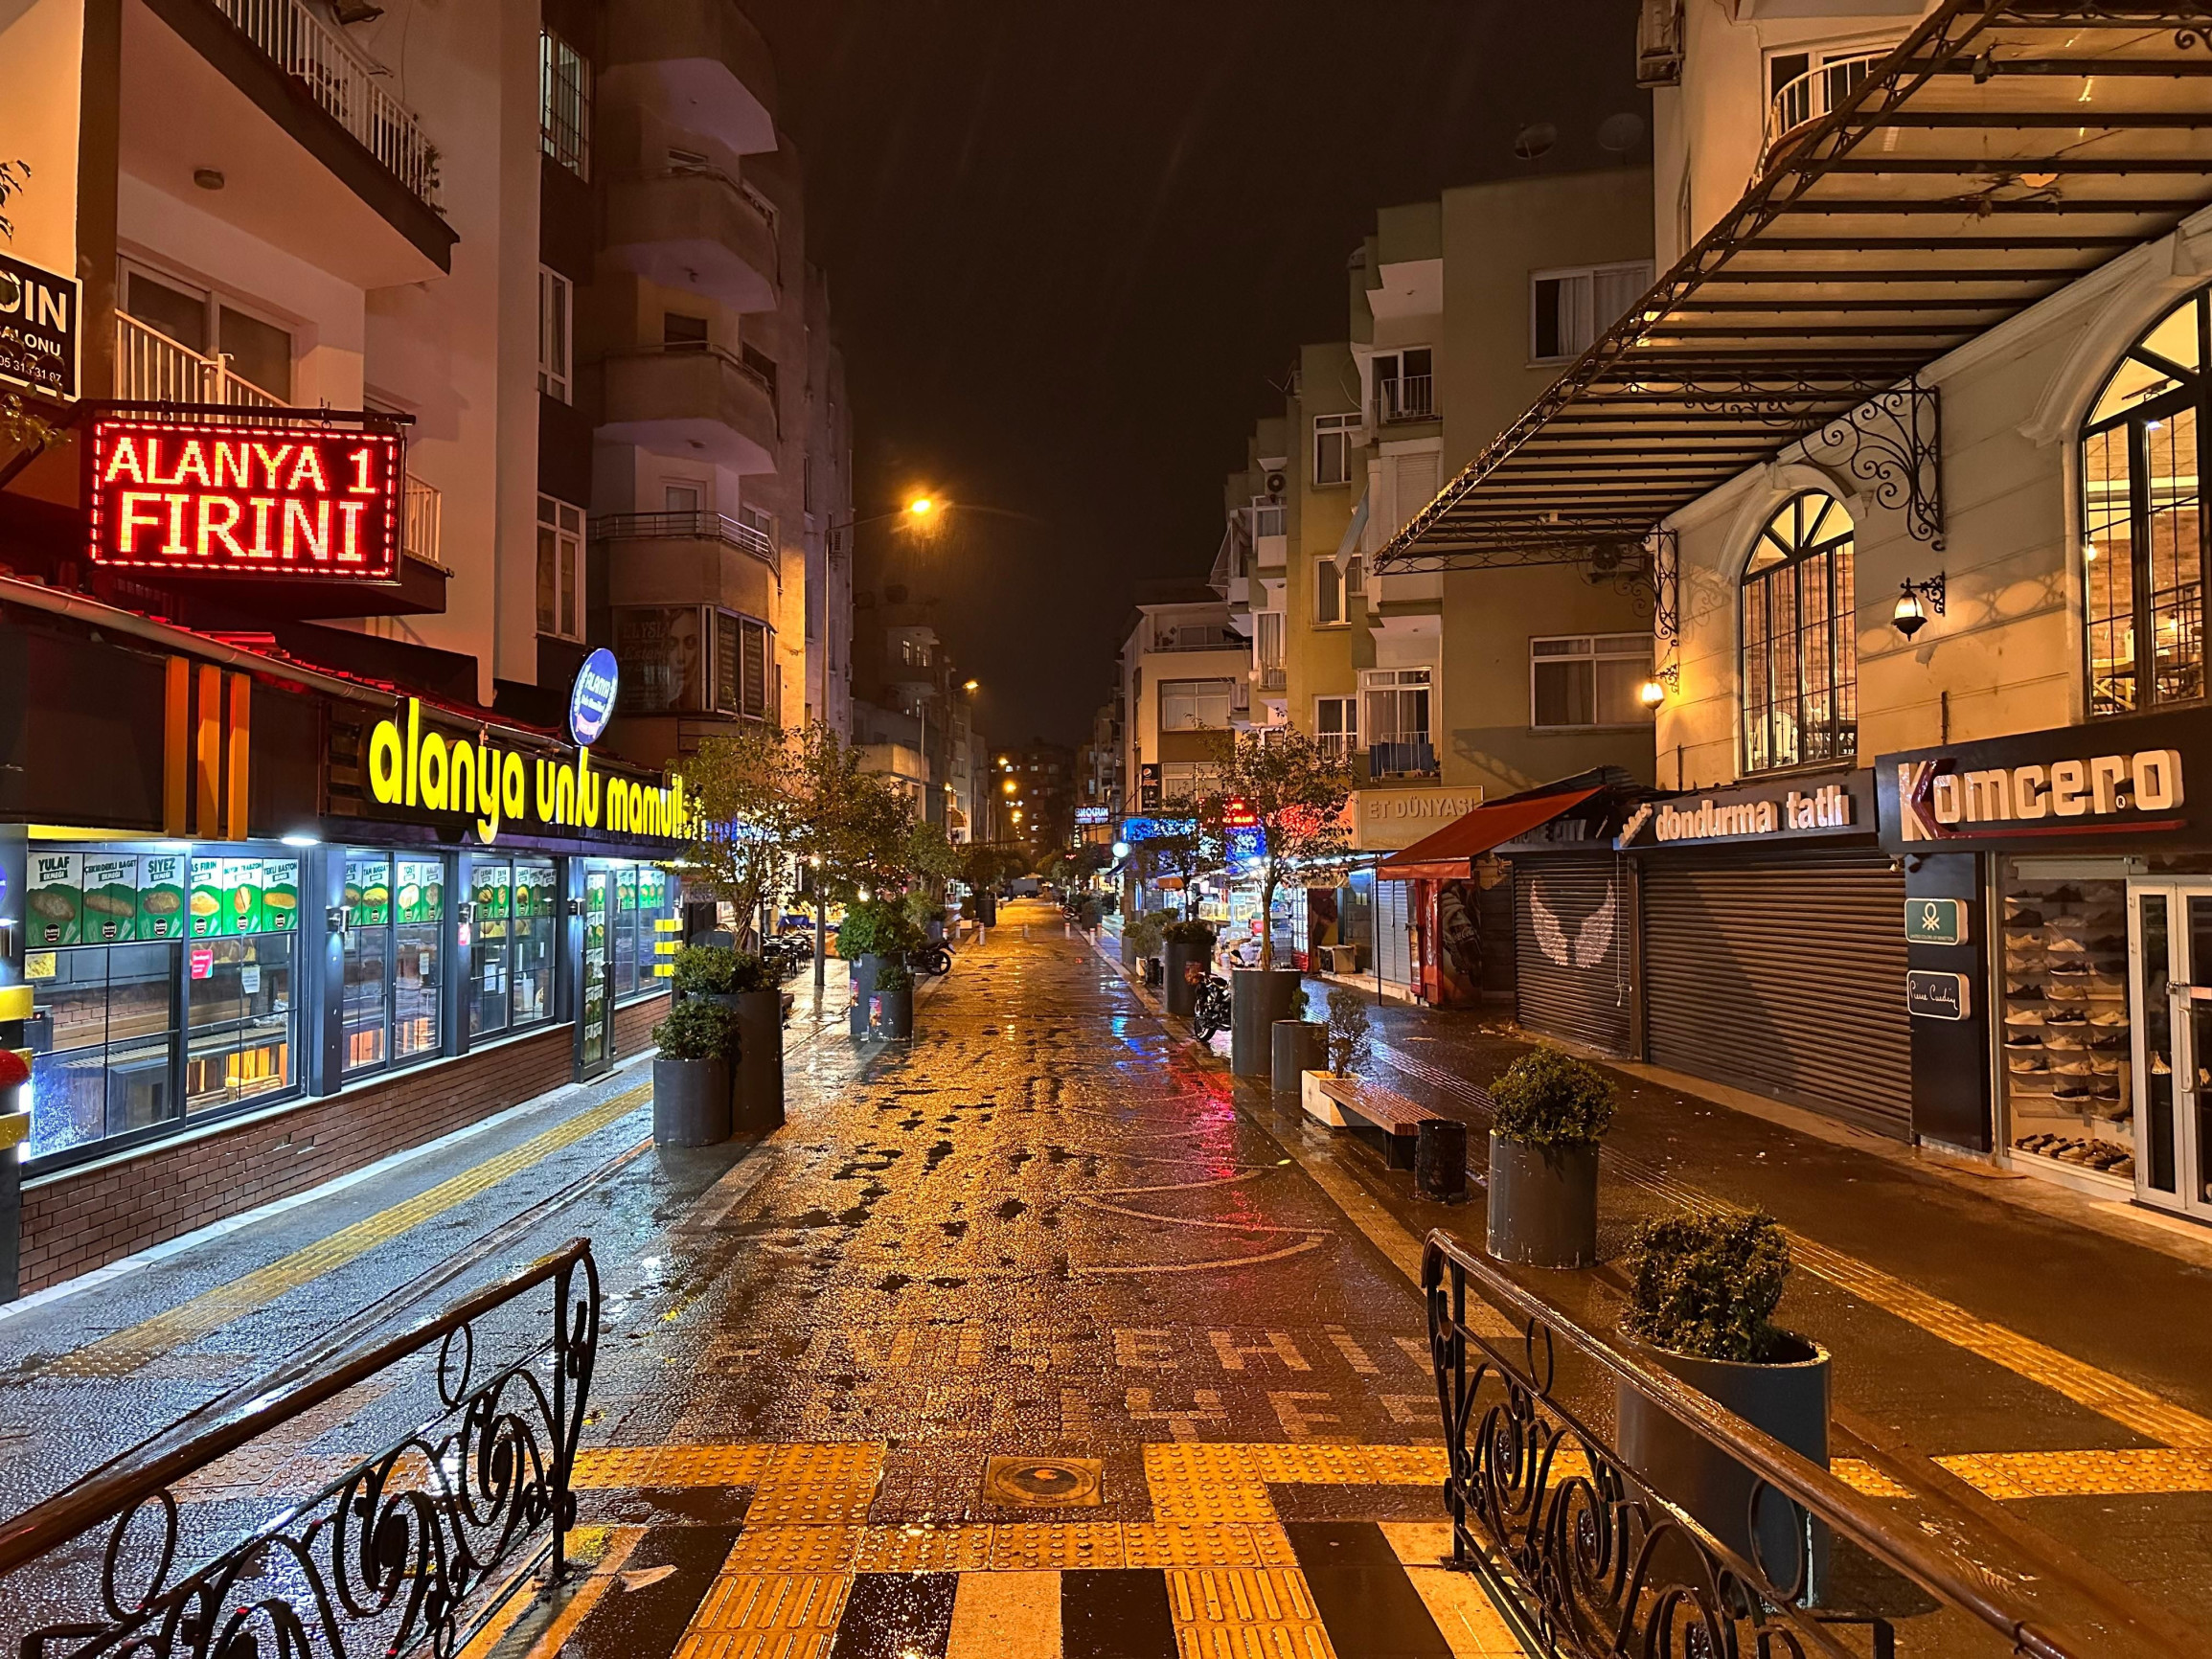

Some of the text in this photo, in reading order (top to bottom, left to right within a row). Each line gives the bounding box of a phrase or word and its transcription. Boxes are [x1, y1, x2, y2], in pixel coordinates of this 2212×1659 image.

[104, 436, 377, 494] ALANYA 1
[118, 491, 368, 562] FIRINI
[584, 671, 611, 699] ALANYA
[369, 696, 525, 845] alanya
[536, 745, 600, 829] unlu
[1368, 796, 1475, 820] ET DÜNYASI
[1898, 749, 2185, 842] Komcero
[1655, 799, 1779, 842] dondurma
[37, 855, 70, 872] YULAF
[118, 858, 137, 871] BAGET
[148, 857, 176, 874] SİYEZ
[278, 862, 298, 873] BASTON
